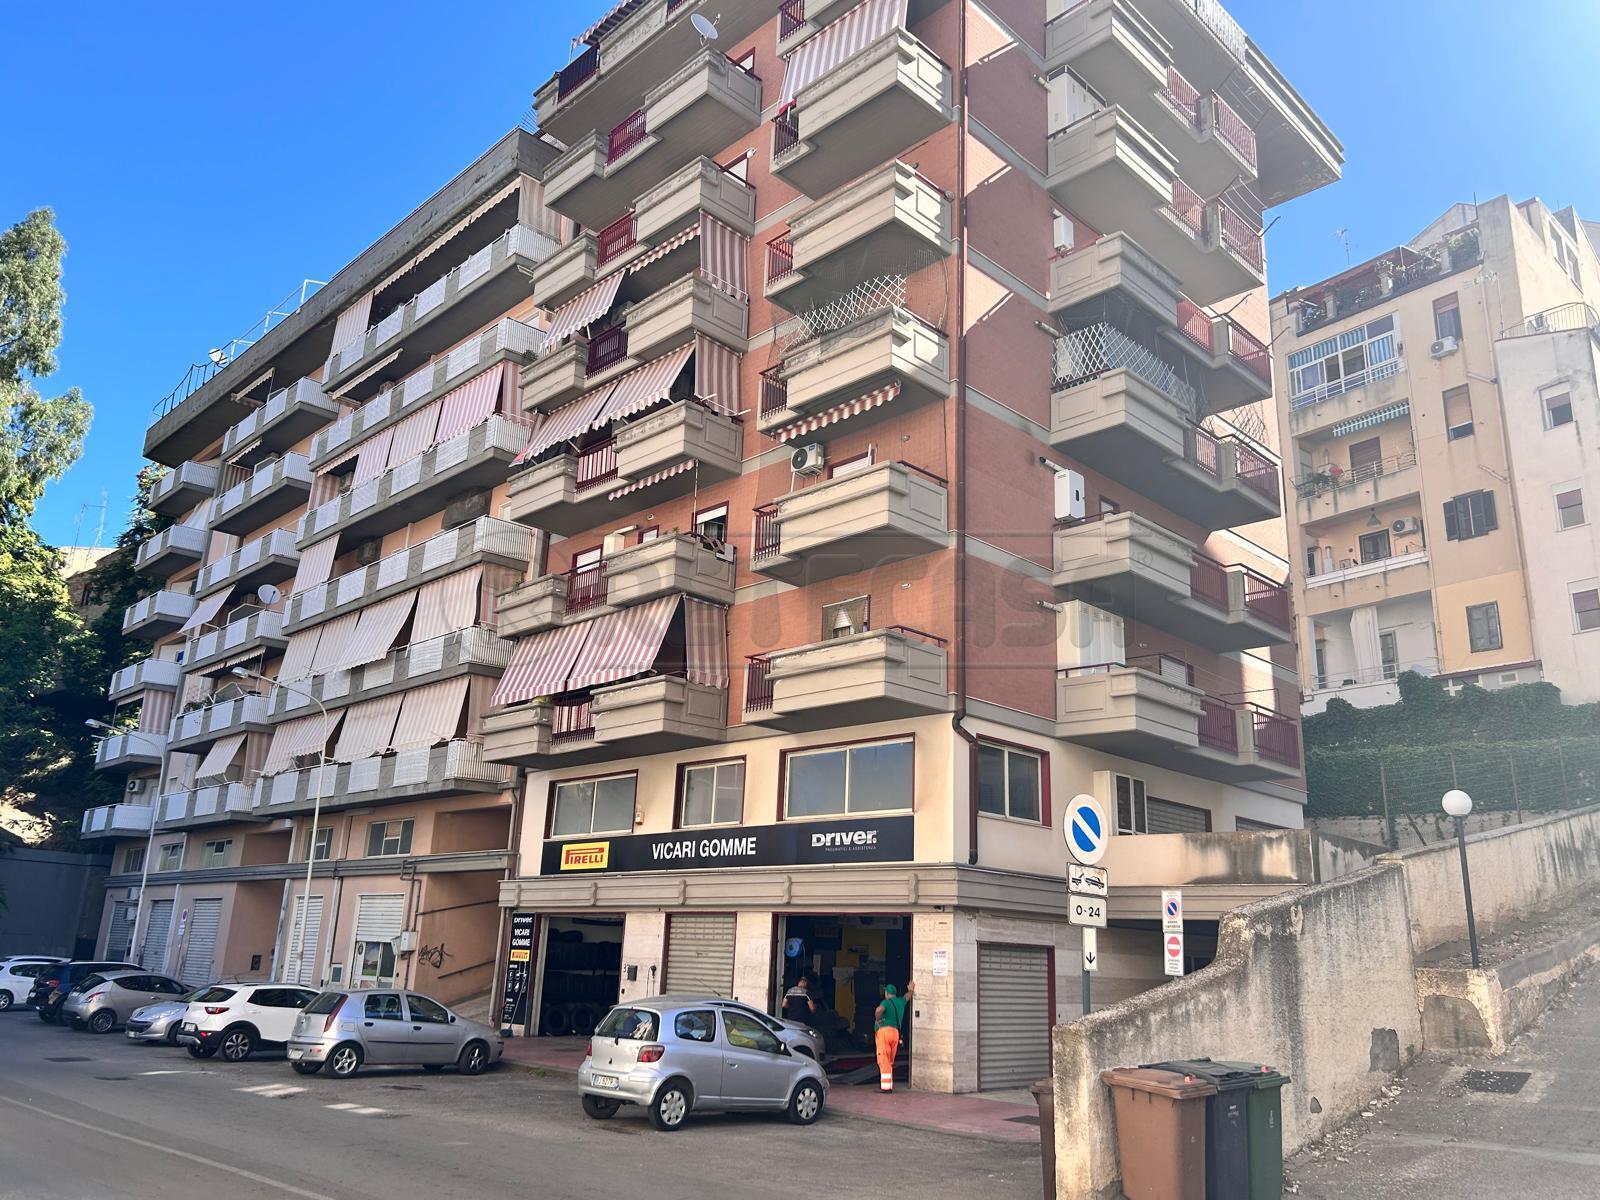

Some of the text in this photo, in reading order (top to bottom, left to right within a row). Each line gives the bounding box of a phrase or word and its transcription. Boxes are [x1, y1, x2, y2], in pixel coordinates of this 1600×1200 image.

[652, 837, 757, 860] VICARI GOMME
[565, 847, 605, 865] PIRELLI
[514, 928, 531, 936] VICARI
[511, 938, 531, 946] GOMME
